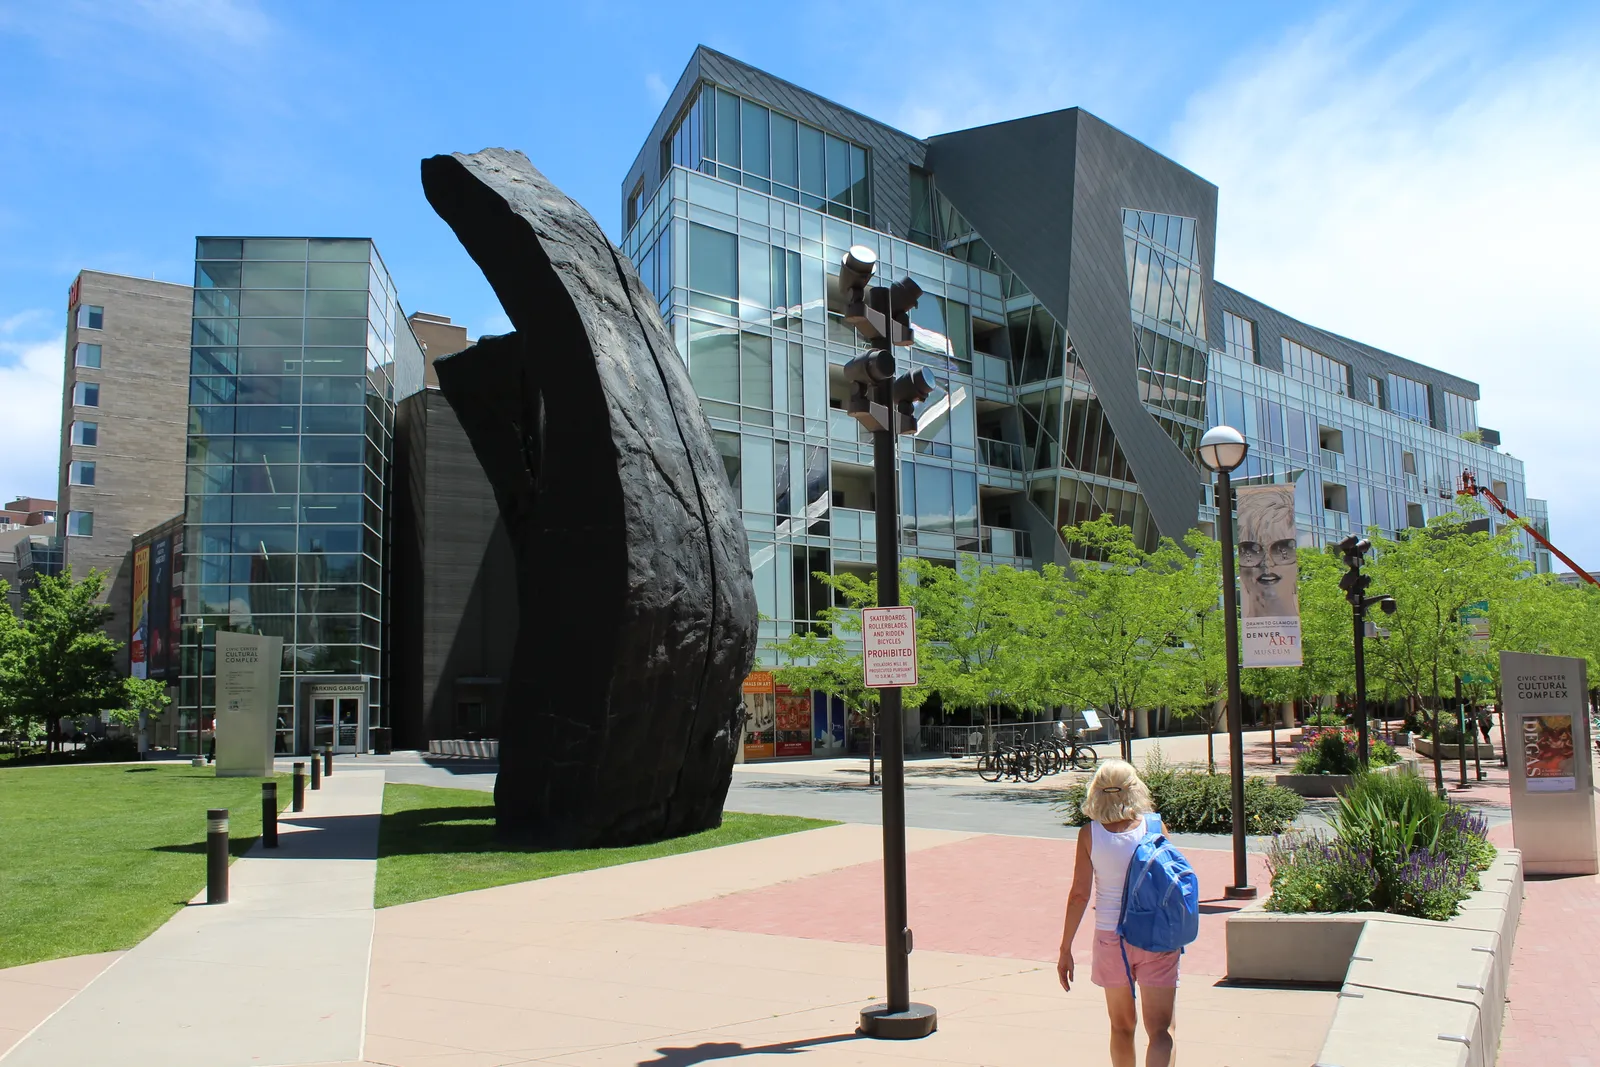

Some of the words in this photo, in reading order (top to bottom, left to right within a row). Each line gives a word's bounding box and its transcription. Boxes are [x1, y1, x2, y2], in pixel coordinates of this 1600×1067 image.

[1269, 636, 1297, 645] ART
[868, 649, 912, 658] PROHIBITED
[1254, 648, 1291, 656] MUSEUM
[1517, 682, 1568, 691] CULTURAL
[1518, 691, 1568, 699] COMPLEX
[1523, 719, 1541, 777] DEGAS
